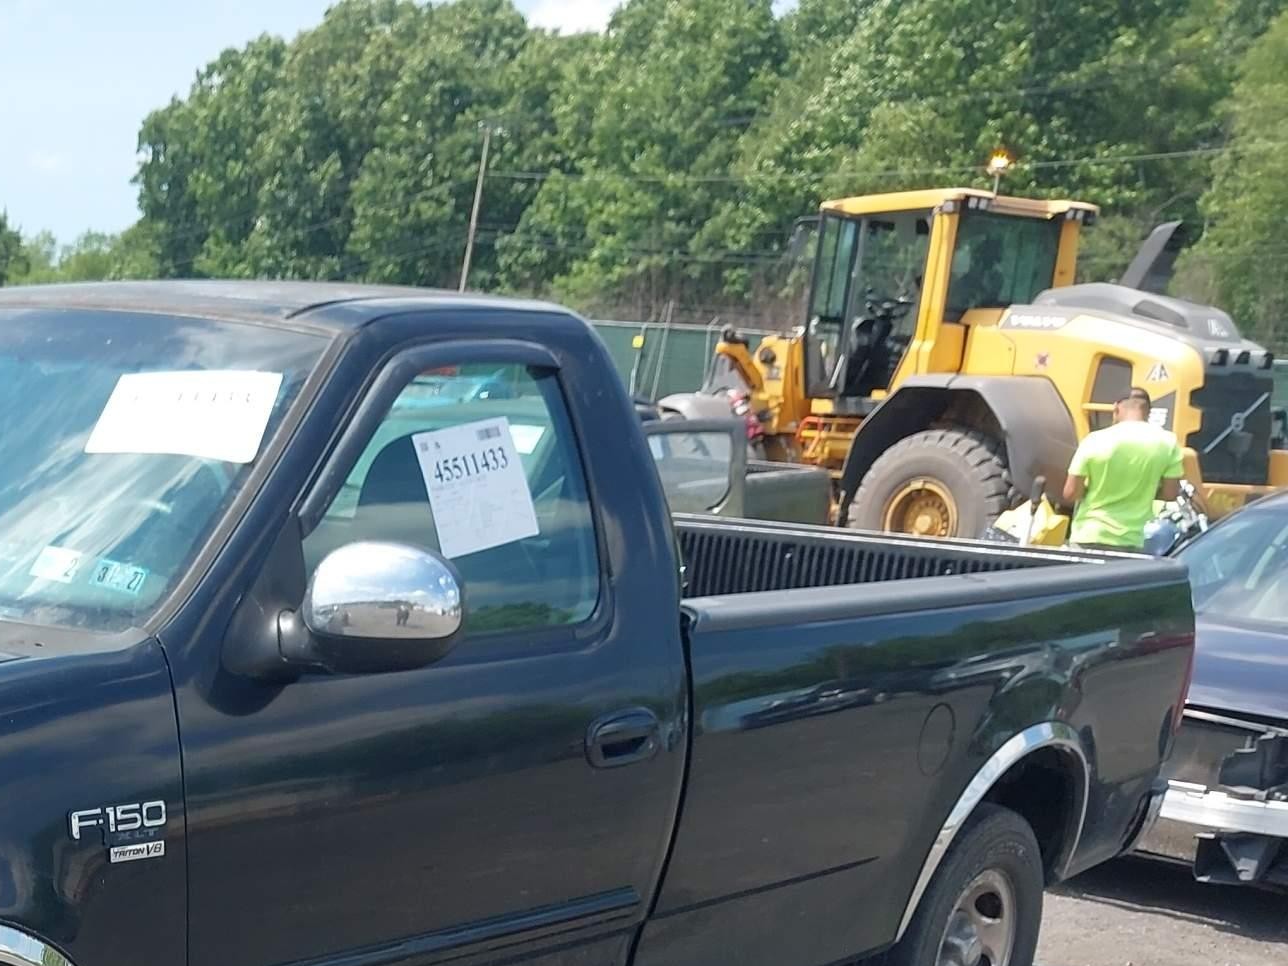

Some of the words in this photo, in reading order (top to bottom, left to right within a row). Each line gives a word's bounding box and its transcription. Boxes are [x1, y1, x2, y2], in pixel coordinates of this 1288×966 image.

[434, 447, 509, 482] 45511433
[71, 800, 167, 840] F-150
[114, 847, 145, 859] TRITON
[146, 843, 163, 857] V8
